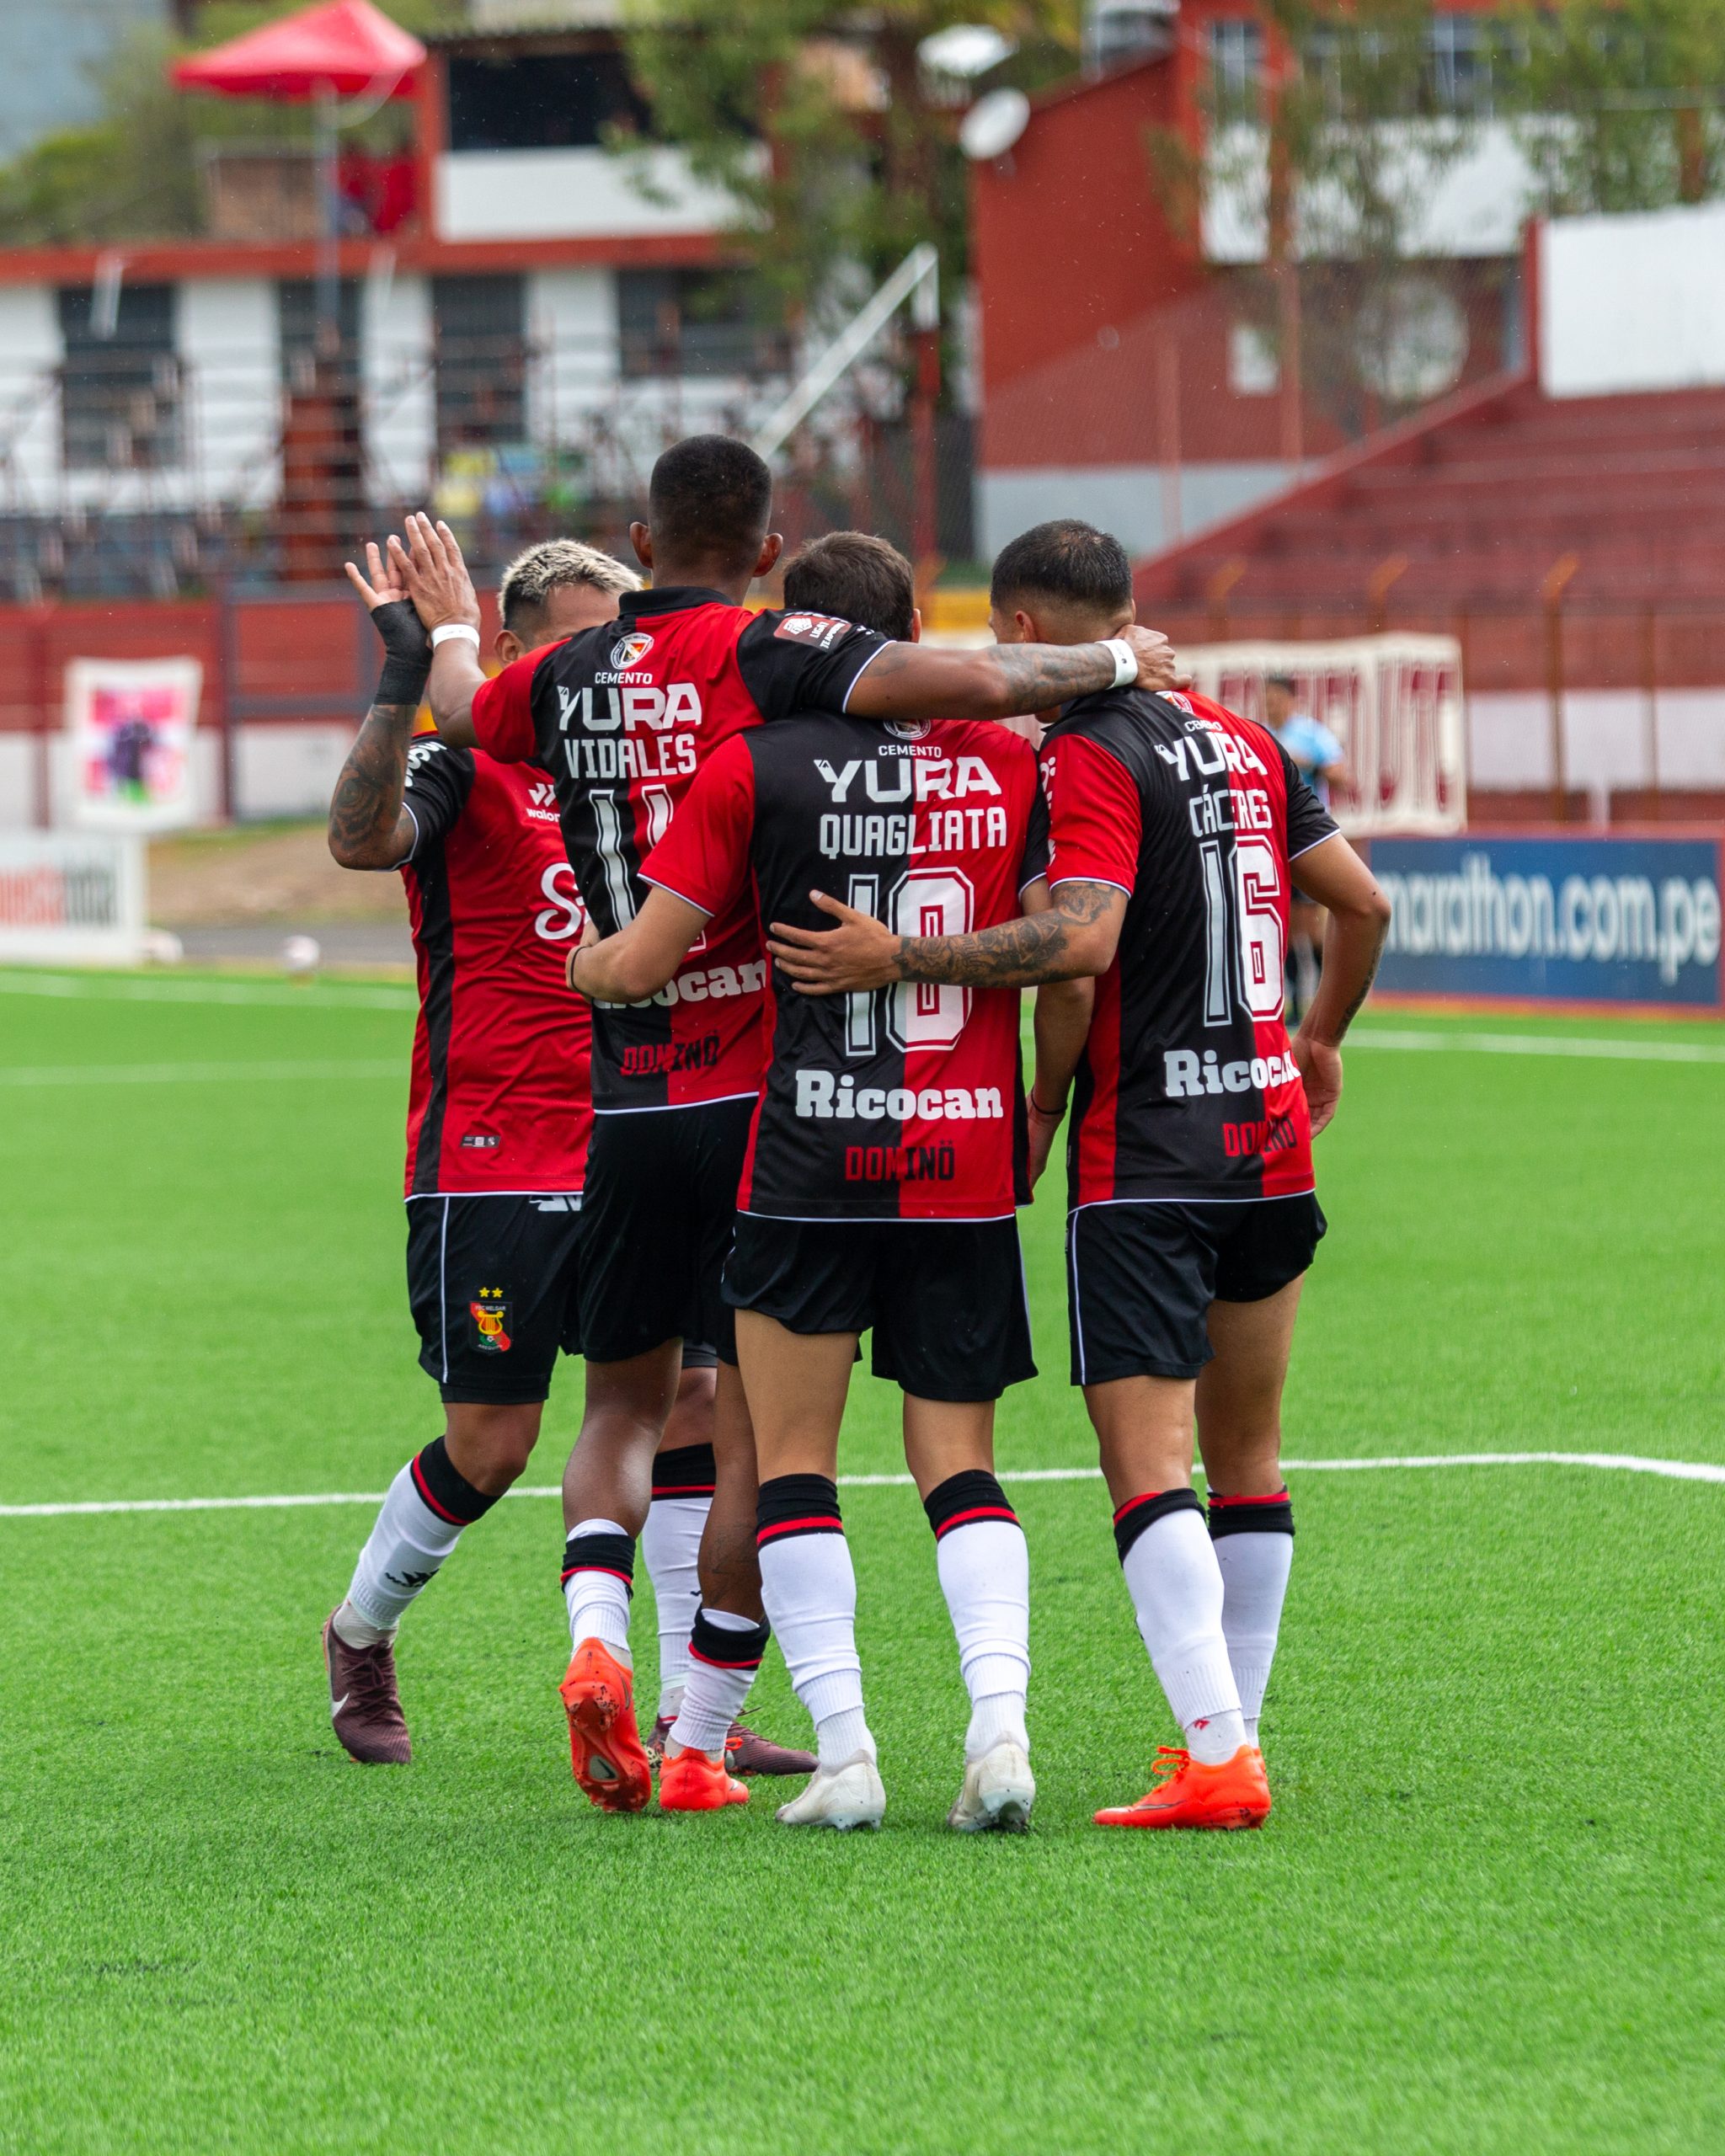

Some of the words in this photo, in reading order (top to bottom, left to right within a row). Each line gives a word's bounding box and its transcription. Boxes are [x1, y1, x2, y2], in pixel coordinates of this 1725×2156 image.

[595, 672, 653, 685] CEMENTO
[557, 682, 702, 731] YURA
[563, 733, 697, 779] VIDALES
[879, 744, 943, 758] CEMENTO
[1154, 731, 1268, 782] YURA
[813, 756, 1002, 803] YURA
[819, 806, 1007, 860] QUAGLIATA
[1199, 835, 1285, 1027] 16
[593, 959, 767, 1010] ocan
[795, 1070, 1004, 1120] Ricocan
